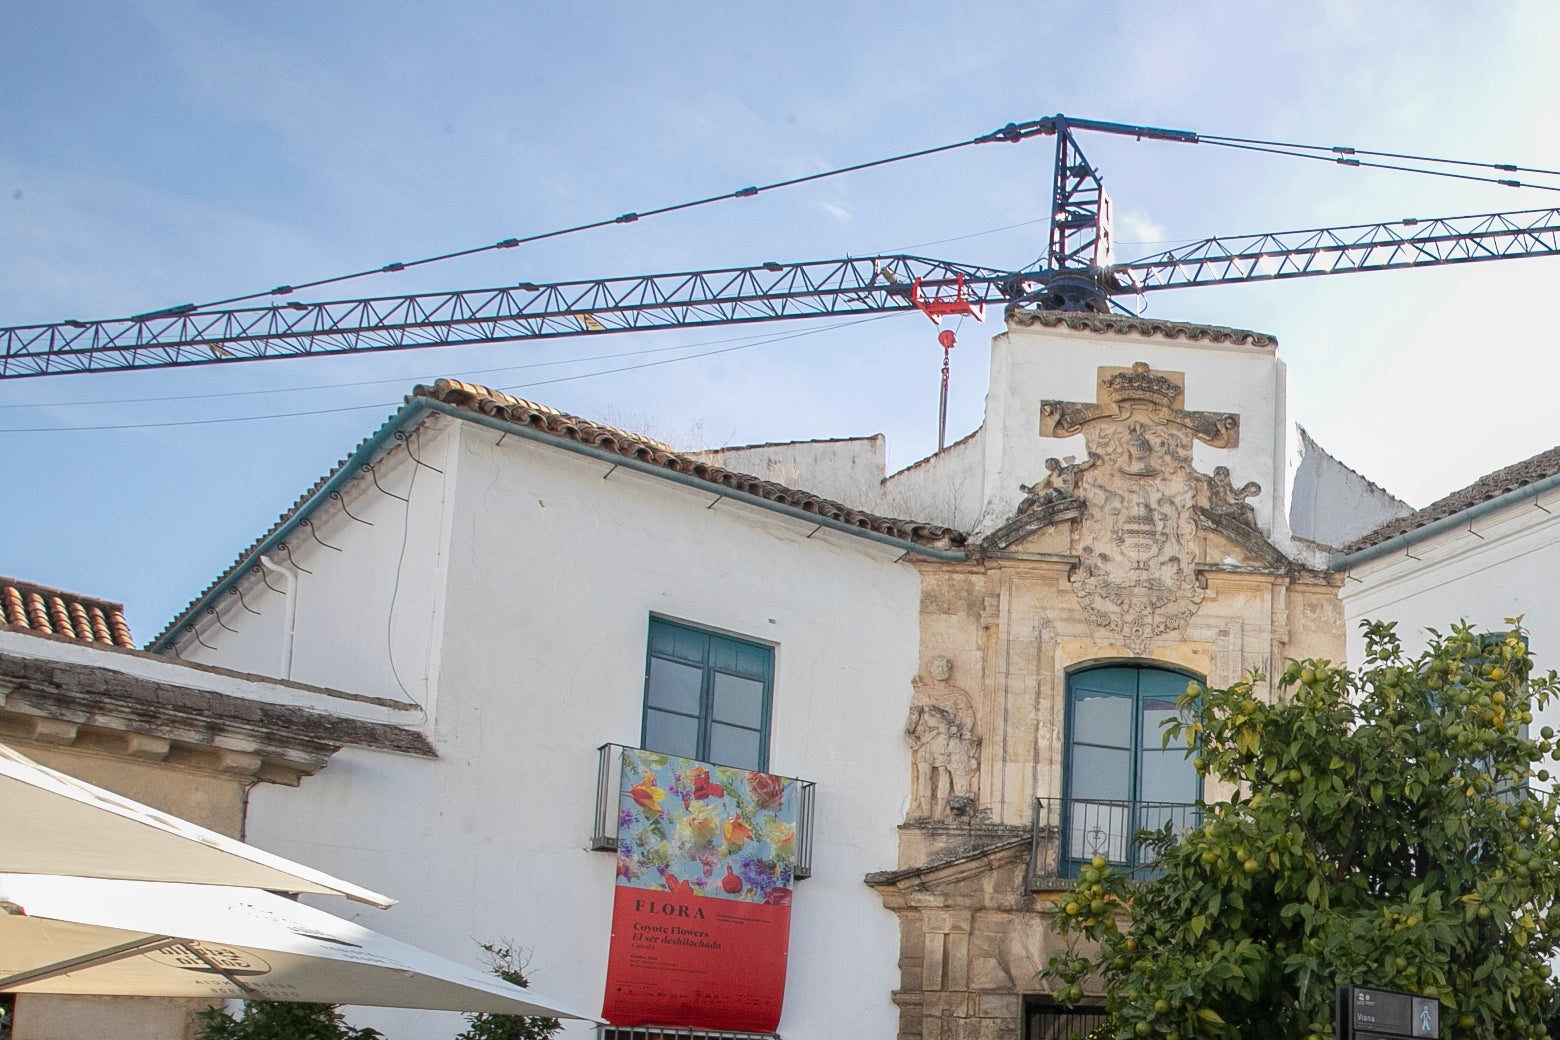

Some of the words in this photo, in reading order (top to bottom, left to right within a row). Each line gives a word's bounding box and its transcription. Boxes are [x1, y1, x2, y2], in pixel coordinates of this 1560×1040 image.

[634, 899, 705, 919] FLORA
[633, 922, 669, 935] Coyote
[671, 926, 709, 938] Flowers
[632, 933, 643, 941] El
[645, 936, 660, 944] ser
[661, 936, 722, 949] deshilachado
[1357, 1013, 1376, 1023] Viana
